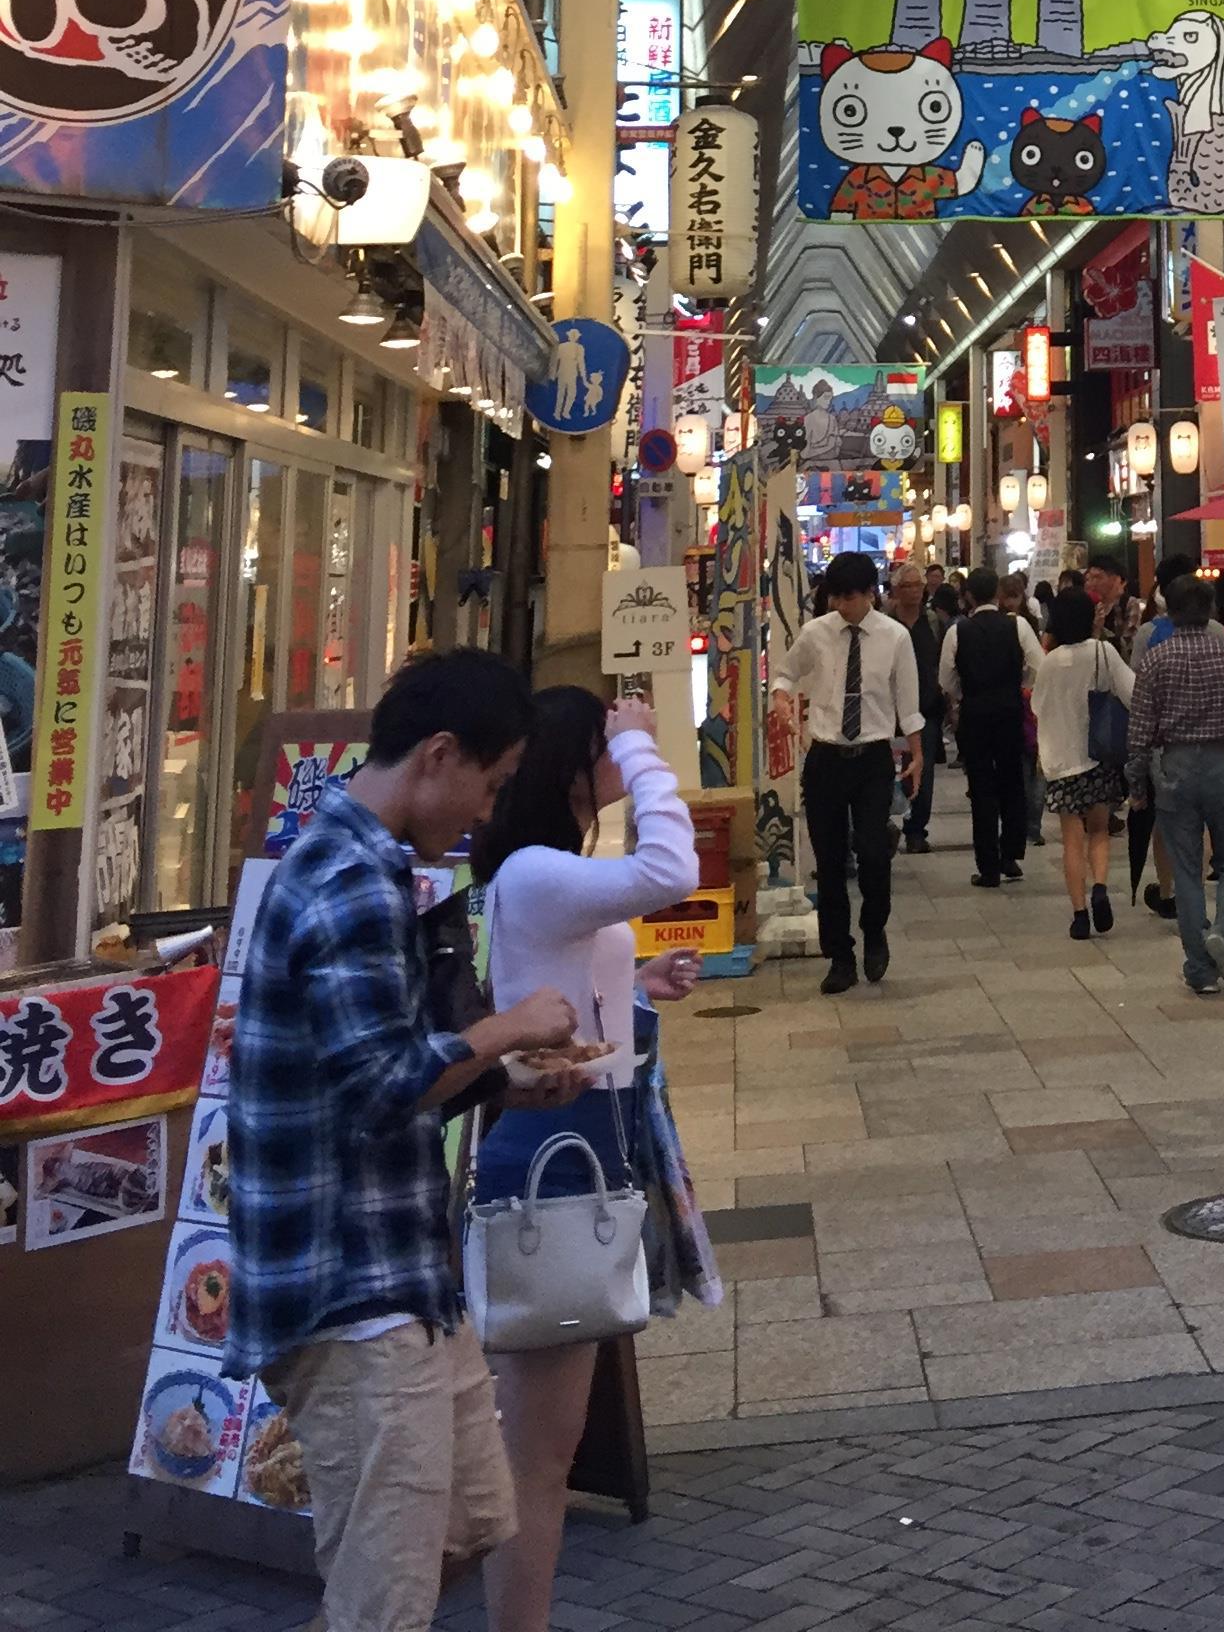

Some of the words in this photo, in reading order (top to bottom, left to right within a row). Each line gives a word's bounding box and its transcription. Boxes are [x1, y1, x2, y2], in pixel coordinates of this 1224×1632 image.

[686, 118, 725, 285] 金久右衛門
[622, 612, 670, 624] tiara
[652, 641, 675, 656] 3F
[655, 923, 706, 943] KIRIN
